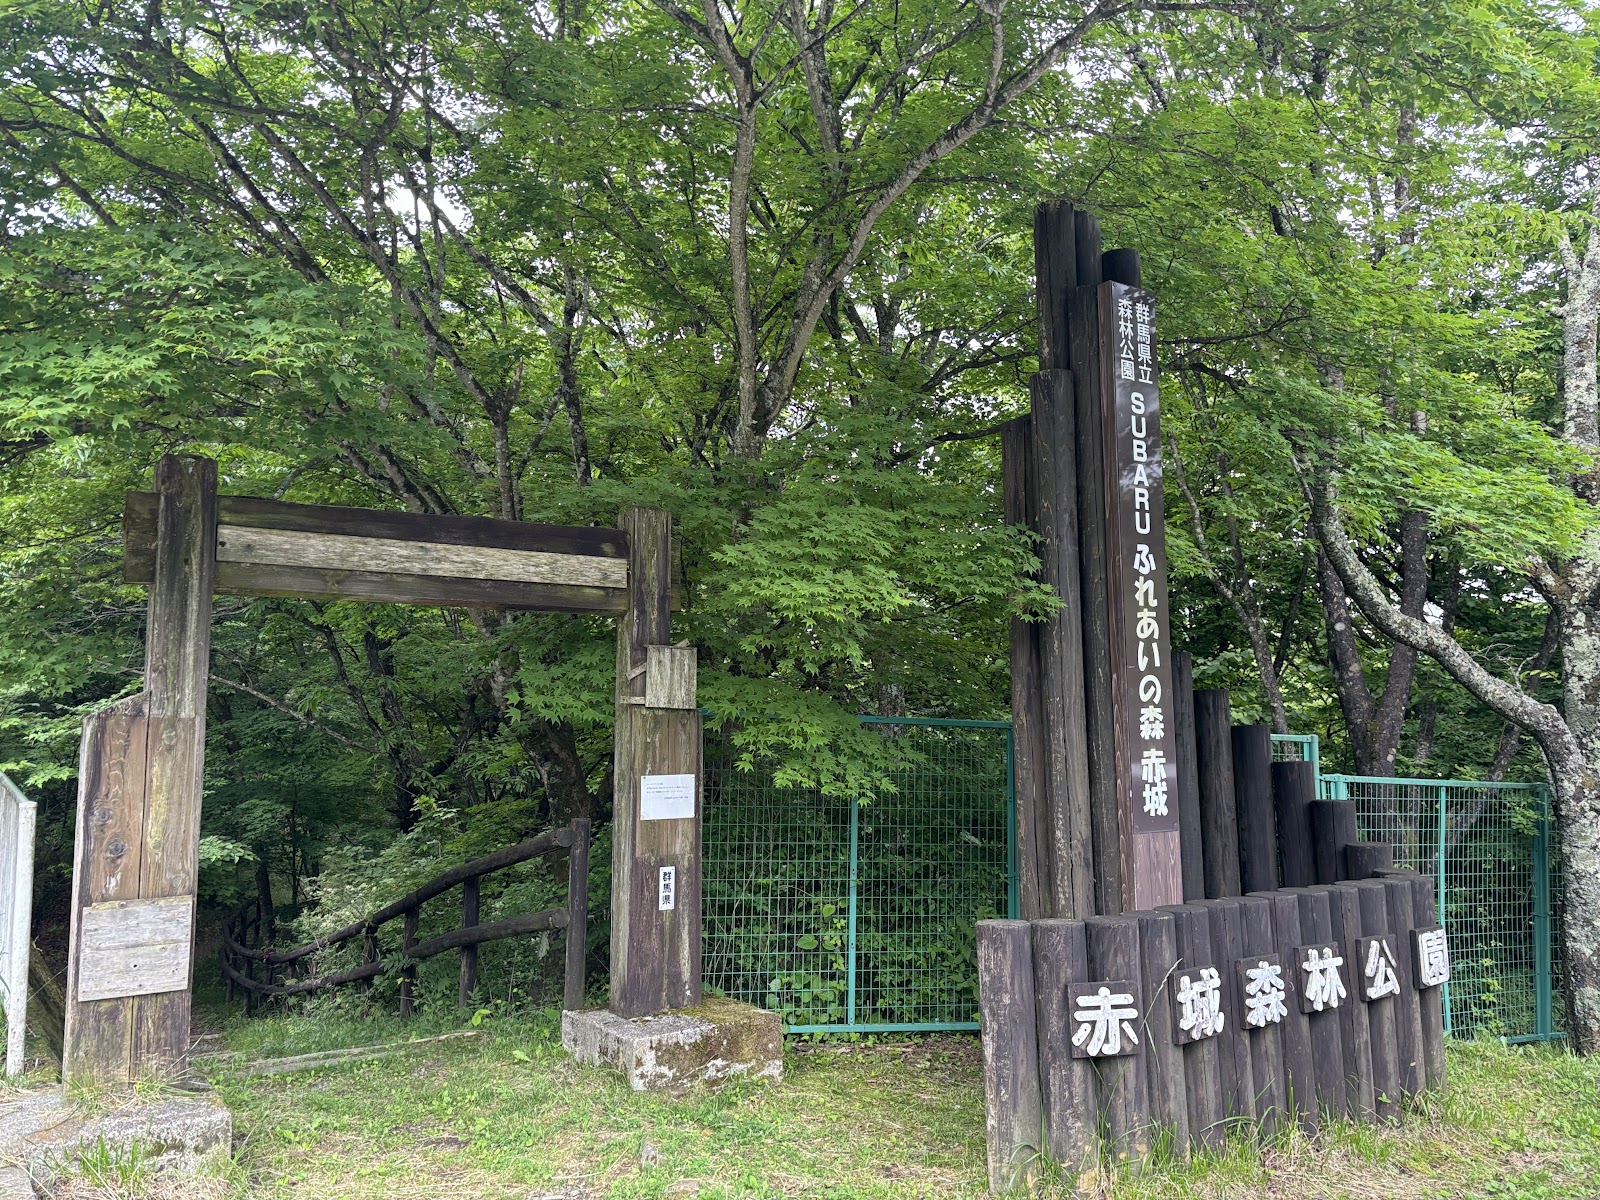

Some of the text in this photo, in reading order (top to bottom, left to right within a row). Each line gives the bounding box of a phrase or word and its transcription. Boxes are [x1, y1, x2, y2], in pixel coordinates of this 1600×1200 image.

[1118, 298, 1135, 382] 森林公園
[1135, 302, 1153, 385] 群馬県立
[1130, 391, 1168, 817] SUBARU ふれあいの森 赤城
[662, 871, 672, 905] 群馬県
[1071, 928, 1450, 1057] 赤城森林公園
